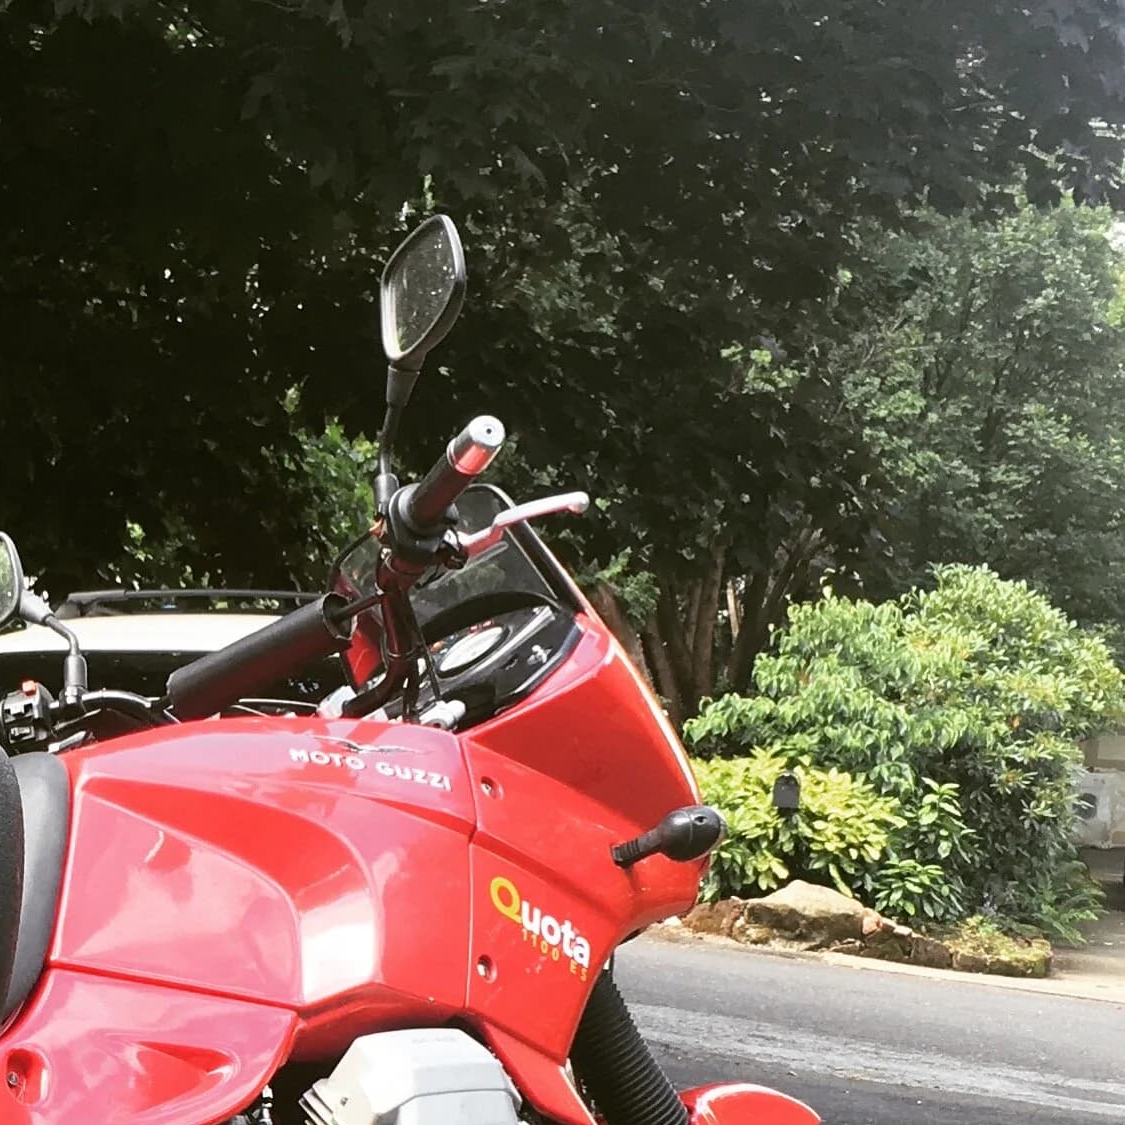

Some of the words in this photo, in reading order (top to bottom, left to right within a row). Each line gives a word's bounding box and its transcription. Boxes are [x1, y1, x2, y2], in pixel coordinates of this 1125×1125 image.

[288, 748, 367, 771] MOTO
[374, 761, 453, 793] GUZZI
[489, 876, 591, 970] Quota
[521, 927, 561, 962] 1100
